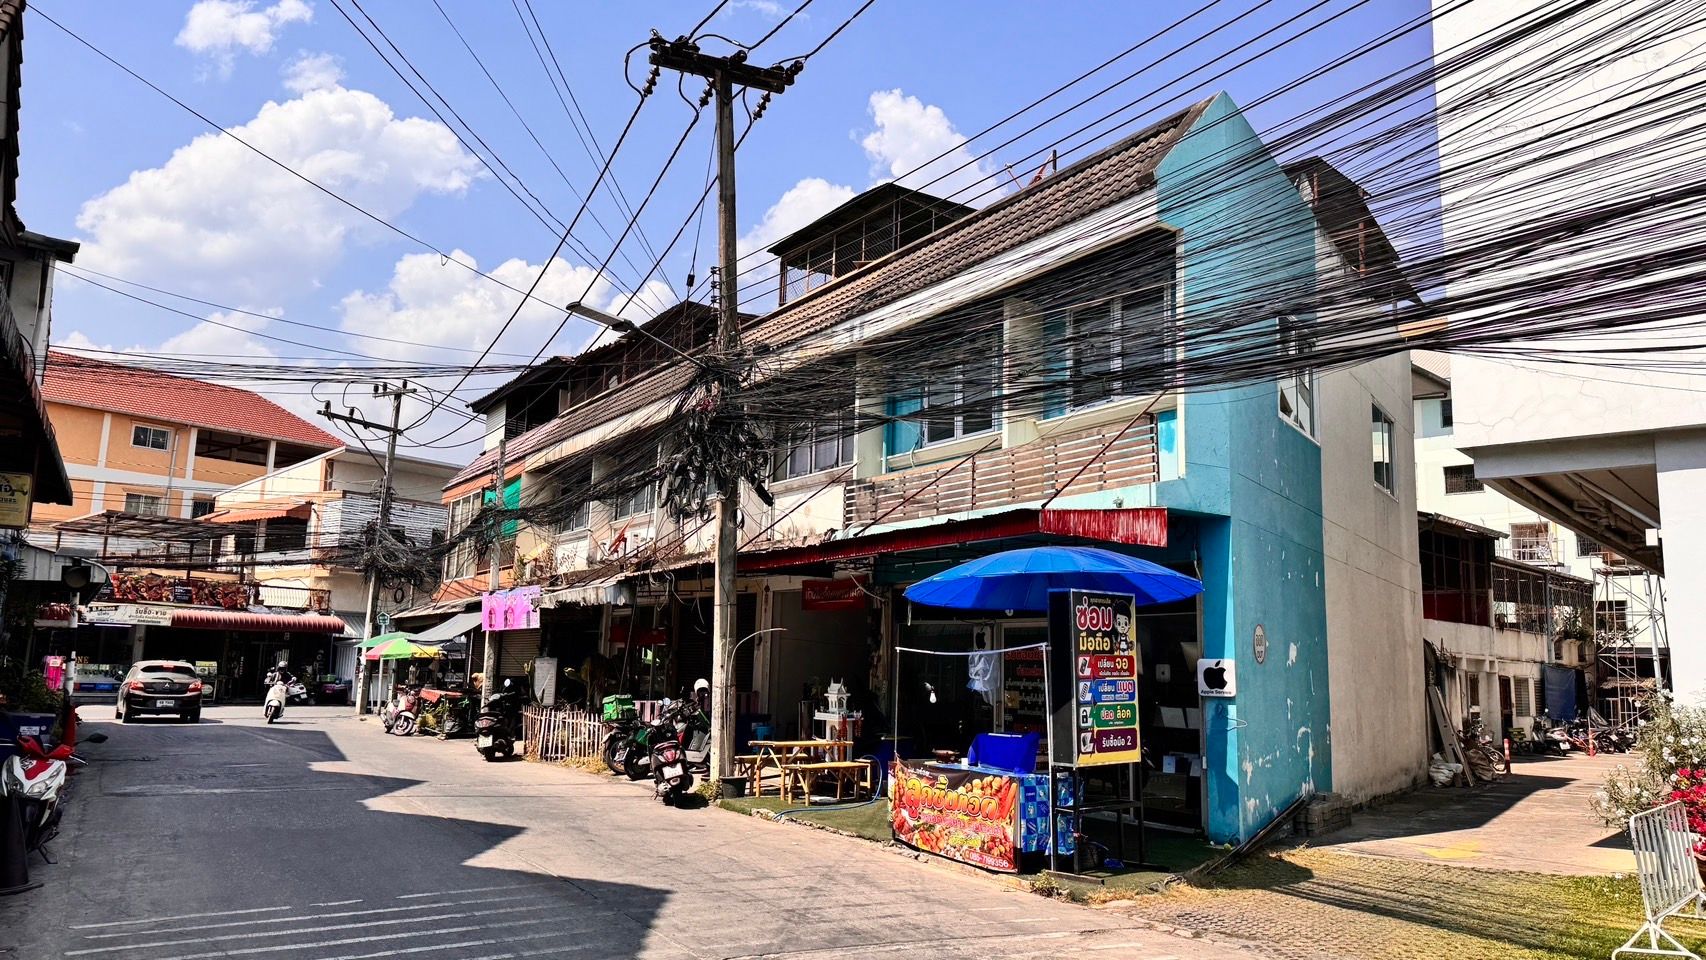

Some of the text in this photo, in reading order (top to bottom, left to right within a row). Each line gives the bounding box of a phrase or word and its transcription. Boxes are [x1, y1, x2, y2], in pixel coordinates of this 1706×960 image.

[1076, 596, 1113, 631] ซ่อม
[1079, 631, 1111, 651] มือถือ
[1115, 657, 1129, 670] จอ
[1126, 735, 1132, 745] 2
[906, 775, 998, 822] ลูกชิ้นทอด
